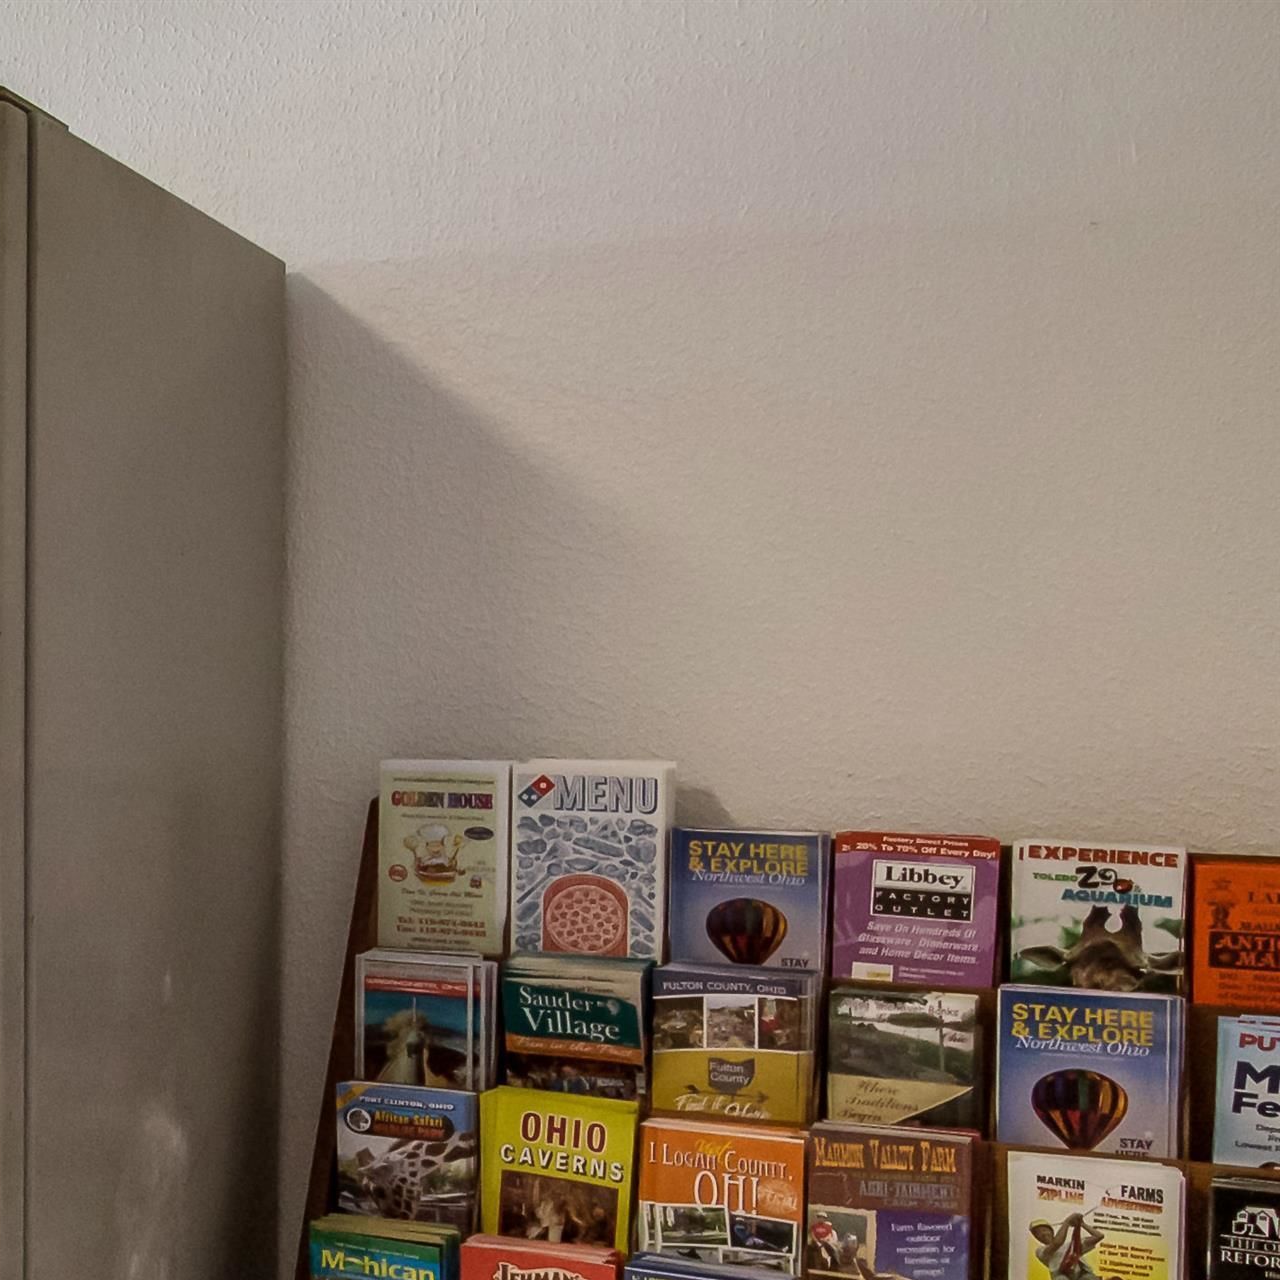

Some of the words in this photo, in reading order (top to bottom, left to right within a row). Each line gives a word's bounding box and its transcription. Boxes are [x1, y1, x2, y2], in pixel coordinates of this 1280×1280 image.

[553, 774, 659, 814] MENU
[688, 840, 744, 858] STAY
[749, 841, 809, 861] HERE
[921, 846, 937, 854] Off
[940, 848, 970, 858] Every
[972, 850, 996, 860] Day!
[1028, 844, 1179, 869] EXPERIENCE
[688, 857, 704, 873] &
[710, 858, 809, 877] EXPLORE
[691, 868, 766, 884] Northwest
[768, 871, 807, 887] Ohio
[885, 865, 964, 889] Libbey
[1032, 871, 1078, 882] TOLEDO
[875, 890, 971, 905] FACTORY
[1061, 888, 1173, 909] AQUARIUM
[874, 904, 969, 918] OUTLET
[780, 958, 809, 969] STAY
[519, 985, 591, 1012] Sauder
[663, 981, 704, 992] FULTON
[706, 981, 755, 994] COUNTY,
[757, 984, 787, 995] OHIO
[521, 1006, 620, 1043] Village
[1011, 1003, 1078, 1023] STAY
[1084, 1007, 1153, 1030] HERE
[1011, 1021, 1031, 1039] &
[1037, 1022, 1153, 1048] EXPLORE
[1015, 1034, 1102, 1054] Northwest
[1106, 1038, 1150, 1057] Ohio
[709, 1061, 744, 1073] Fulton
[710, 1072, 751, 1086] County
[519, 1110, 609, 1154] OHIO
[648, 1141, 656, 1163] I
[1119, 1138, 1154, 1151] STAY
[500, 1143, 625, 1183] CAVERNS
[693, 1170, 760, 1216] OH!
[1036, 1175, 1085, 1191] MARKIN
[1121, 1184, 1164, 1204] FARMS
